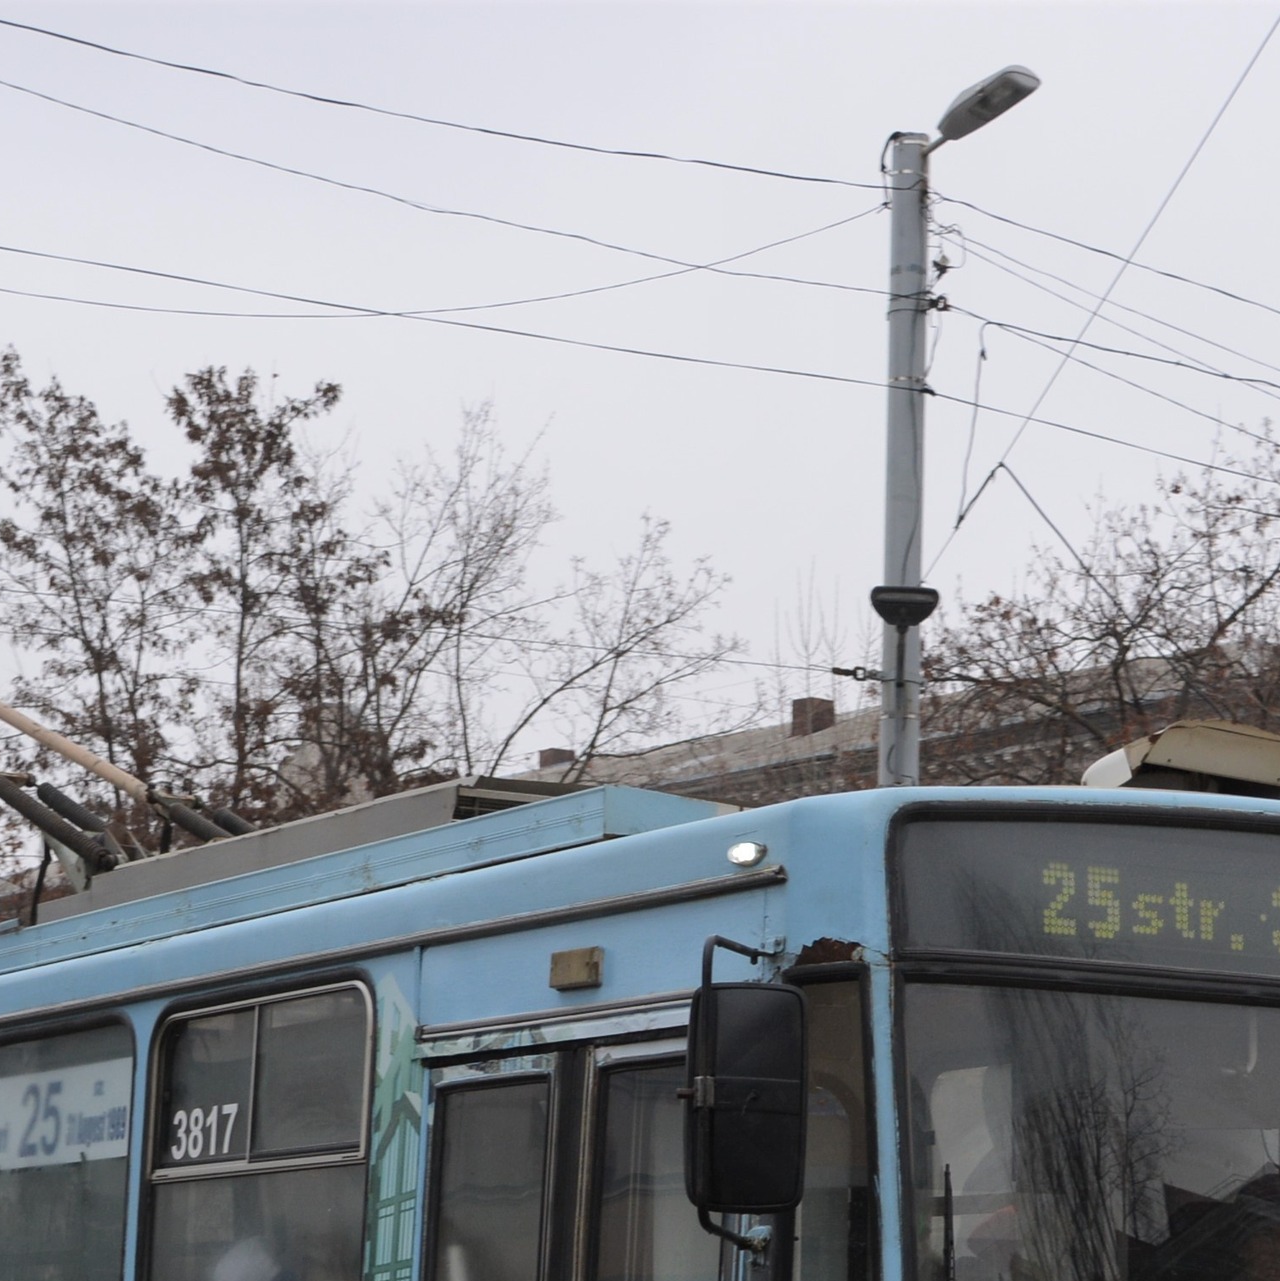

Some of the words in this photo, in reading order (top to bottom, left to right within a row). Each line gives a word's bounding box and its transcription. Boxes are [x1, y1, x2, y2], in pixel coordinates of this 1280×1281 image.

[1042, 862, 1121, 940] 25
[1131, 882, 1245, 953] str.
[19, 1080, 62, 1158] 25
[171, 1103, 239, 1160] 3817
